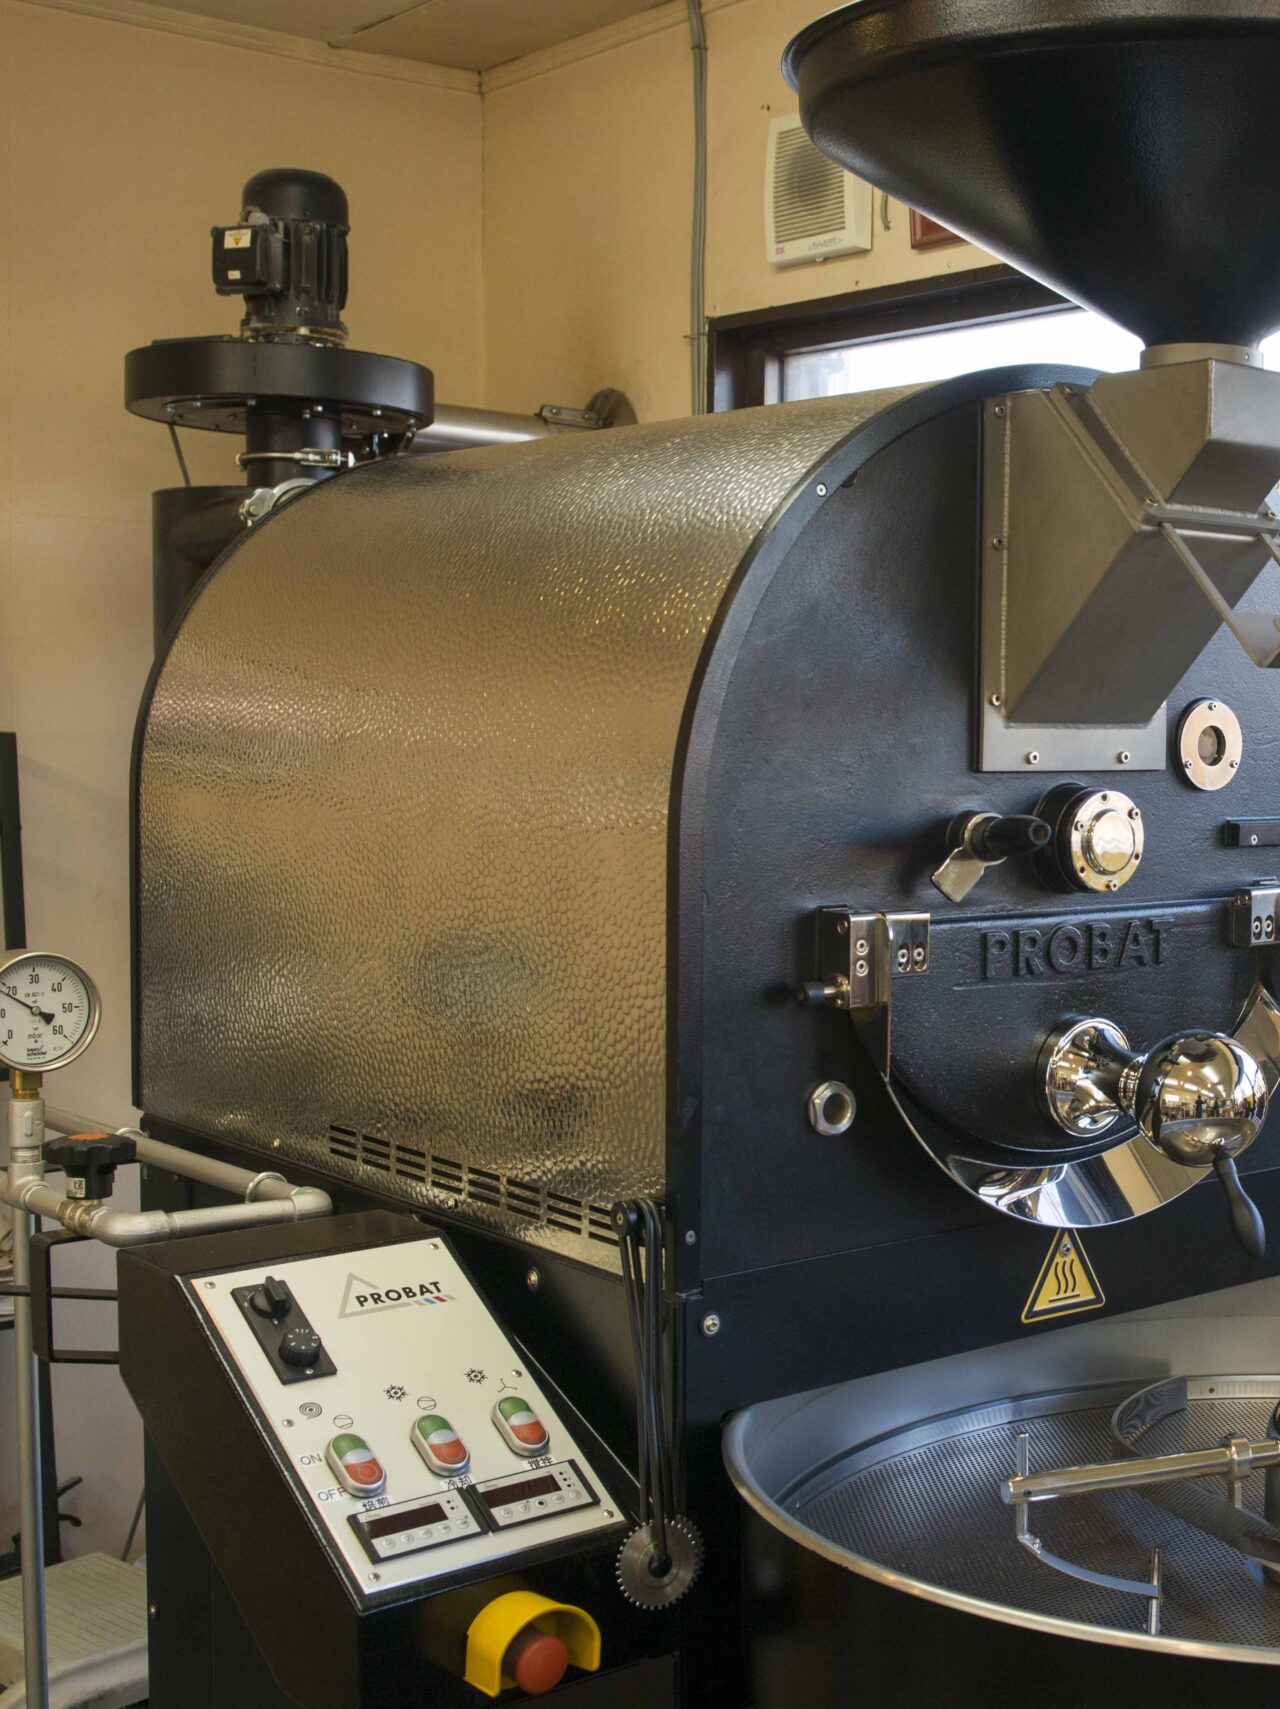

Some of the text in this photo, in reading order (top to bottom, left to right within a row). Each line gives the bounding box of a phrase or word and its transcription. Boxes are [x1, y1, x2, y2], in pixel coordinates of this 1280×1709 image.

[980, 917, 1174, 979] PROBAT
[29, 974, 39, 984] 30
[7, 986, 17, 996] 20
[52, 982, 62, 993] 40
[62, 1003, 73, 1013] 50
[8, 1029, 13, 1039] 0
[52, 1025, 63, 1035] 60
[355, 1281, 442, 1307] PROBAT
[300, 1453, 322, 1466] ON
[444, 1475, 474, 1490] 冷却
[317, 1486, 347, 1501] OFF
